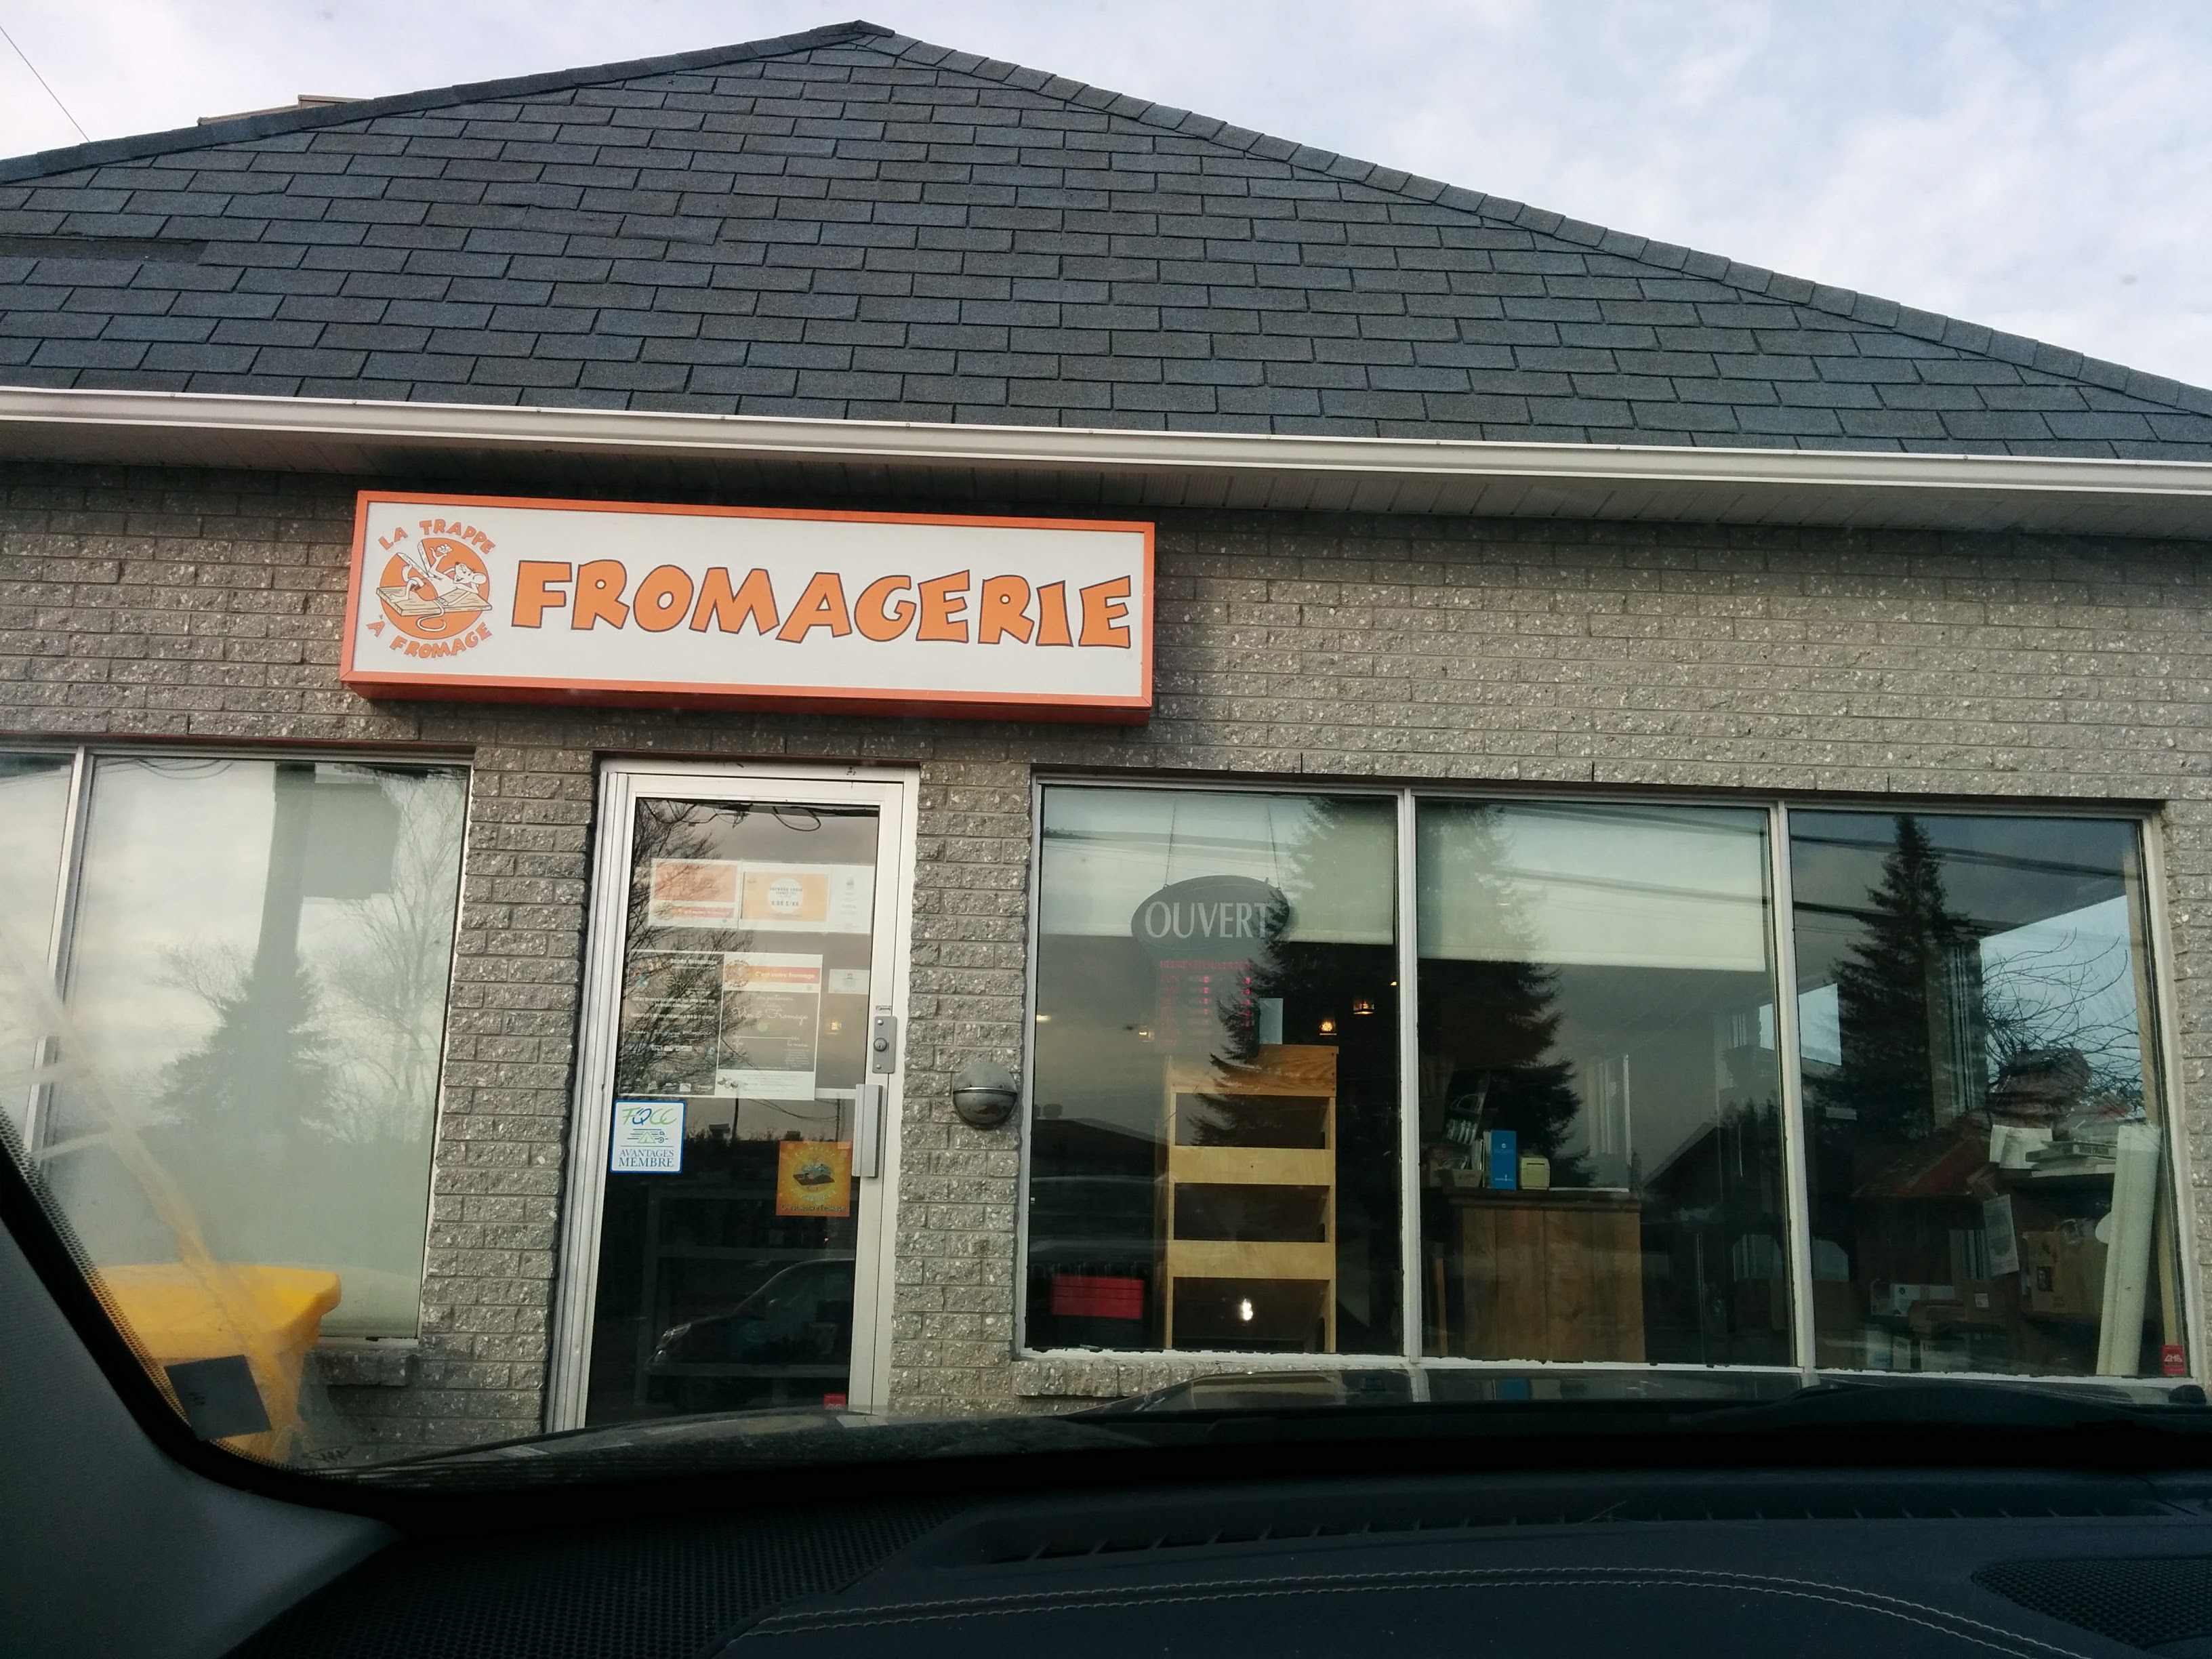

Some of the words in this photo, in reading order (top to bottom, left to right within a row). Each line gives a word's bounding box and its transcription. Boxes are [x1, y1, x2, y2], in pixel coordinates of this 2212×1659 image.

[377, 526, 409, 550] LA
[419, 518, 498, 556] TRAPPE
[510, 558, 1132, 650] FROMAGERIE
[365, 613, 387, 638] À
[388, 621, 495, 659] FROMAGE
[1145, 901, 1269, 939] OUVERT
[789, 972, 815, 980] fromage
[765, 1008, 808, 1026] Fromage
[618, 1157, 674, 1168] MEMBRE
[619, 1149, 675, 1158] AVANTAGES
